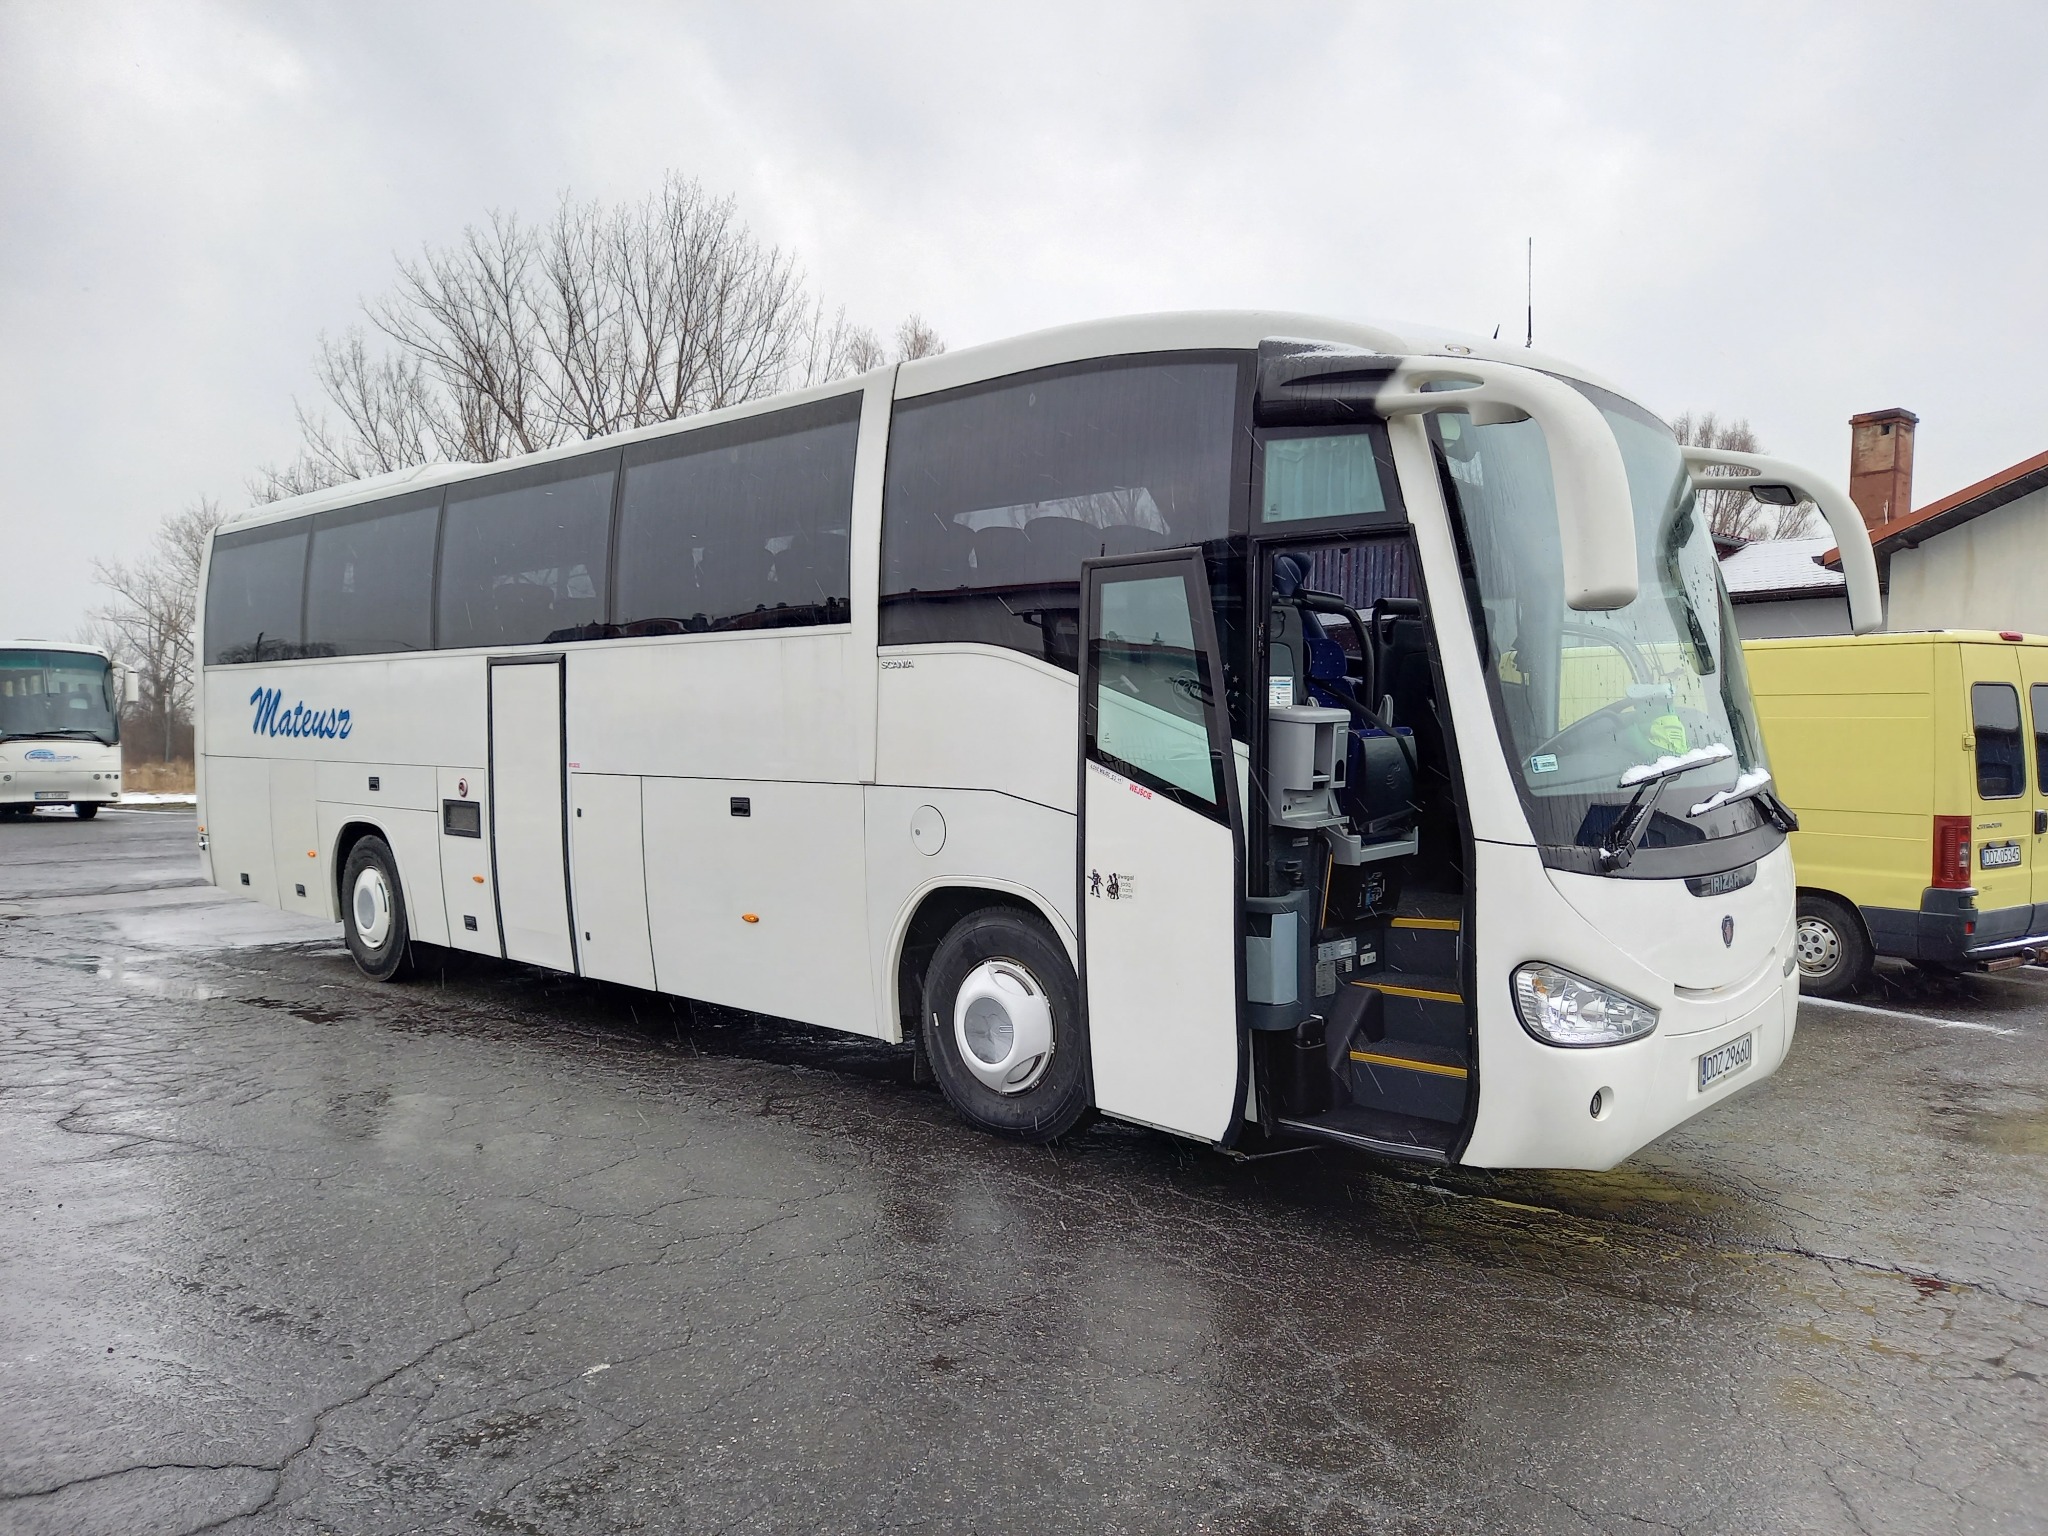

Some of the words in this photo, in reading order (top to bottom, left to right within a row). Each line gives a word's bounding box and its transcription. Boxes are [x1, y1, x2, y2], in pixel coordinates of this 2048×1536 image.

[881, 660, 915, 670] SCANIA
[250, 686, 352, 739] Mateusz
[1129, 783, 1153, 800] WEJŚCIE
[1985, 849, 1999, 865] DDZ
[1999, 847, 2020, 863] 05345
[1711, 873, 1740, 893] IRIZAR
[1706, 1050, 1724, 1081] DDZ
[1725, 1038, 1750, 1071] 29660
